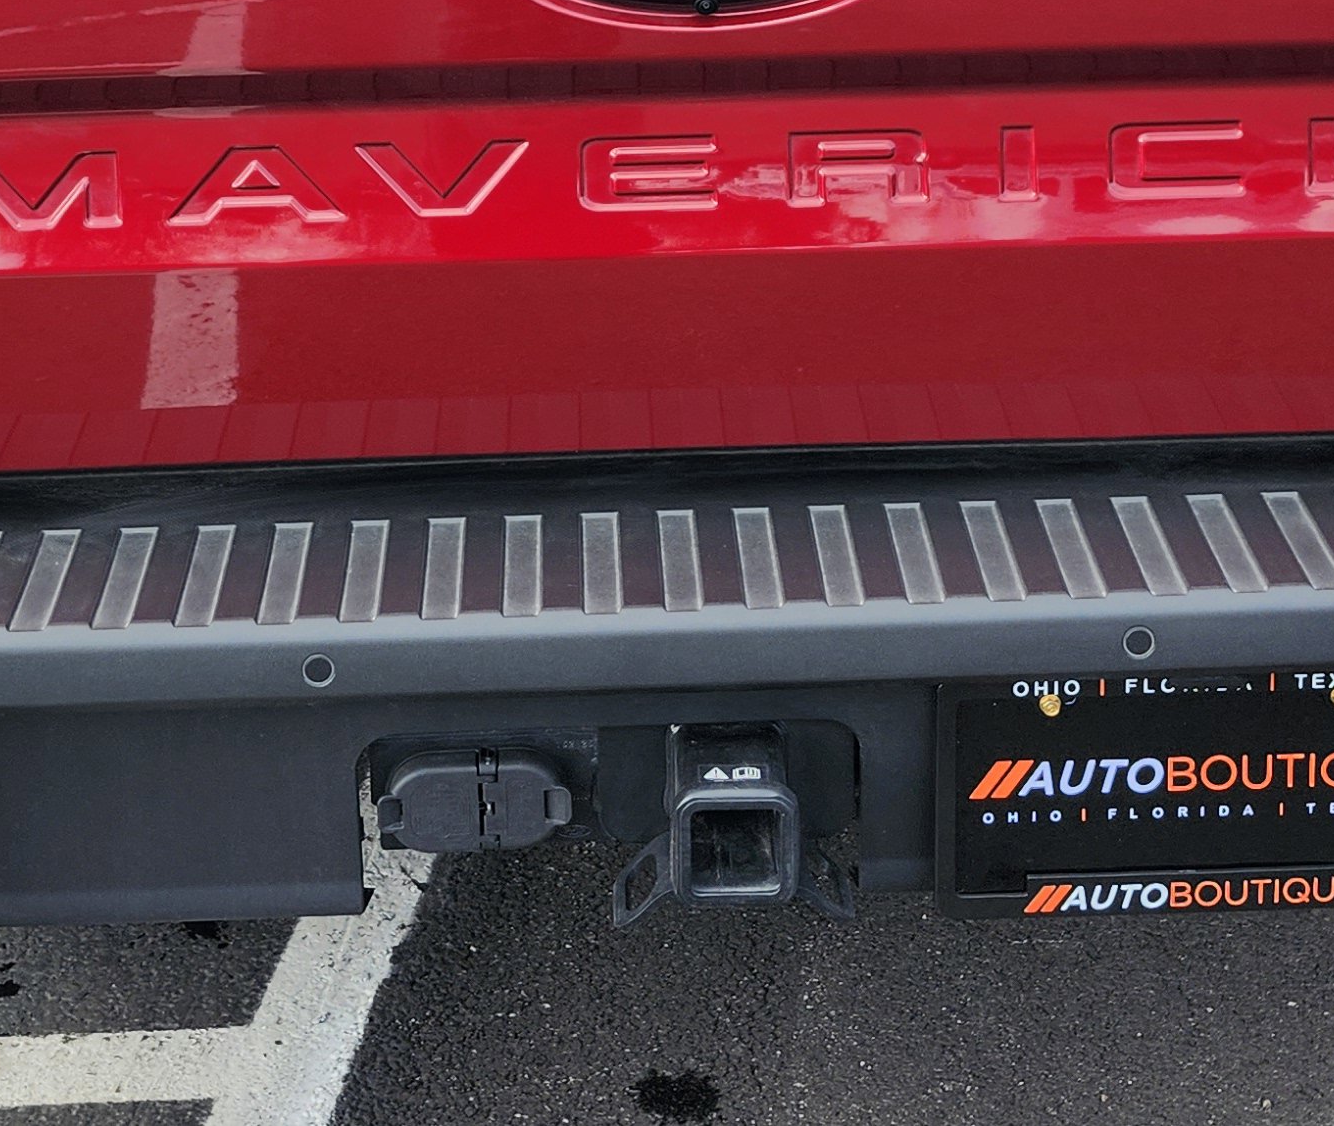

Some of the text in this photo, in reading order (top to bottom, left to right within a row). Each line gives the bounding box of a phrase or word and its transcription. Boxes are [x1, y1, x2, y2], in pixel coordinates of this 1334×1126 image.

[1012, 679, 1081, 698] OHIO
[982, 809, 1063, 825] OHIO
[1107, 804, 1255, 821] FLORIDA
